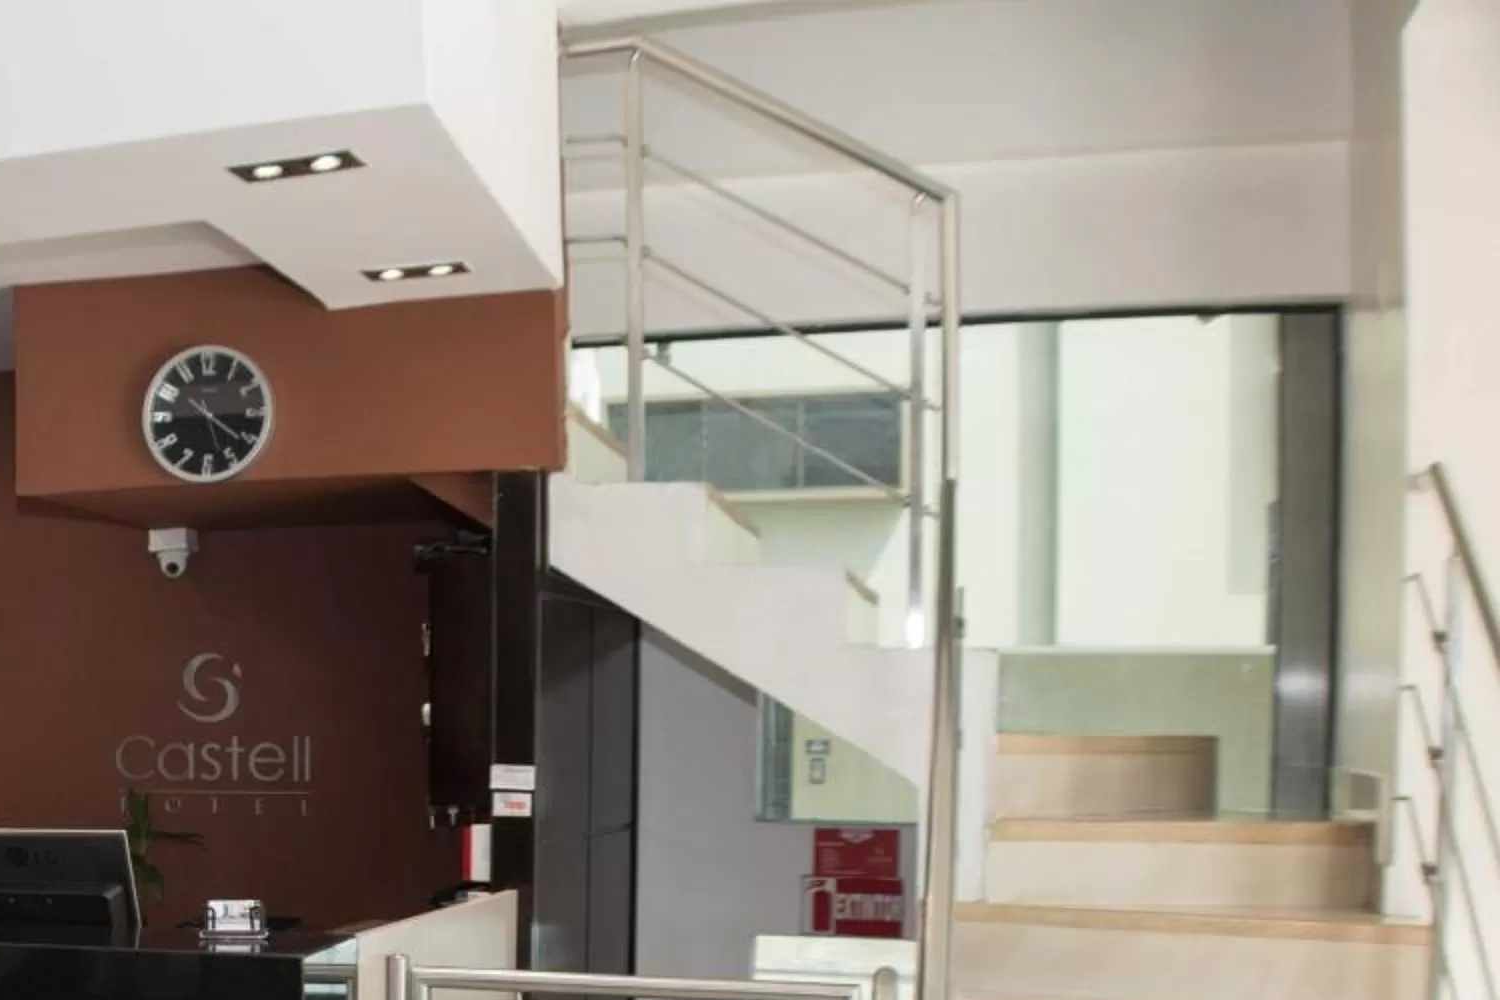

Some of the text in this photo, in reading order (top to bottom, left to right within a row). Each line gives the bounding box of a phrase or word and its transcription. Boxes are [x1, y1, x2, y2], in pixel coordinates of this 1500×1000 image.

[175, 360, 195, 383] 11
[201, 352, 217, 376] 12
[115, 734, 311, 783] Castell
